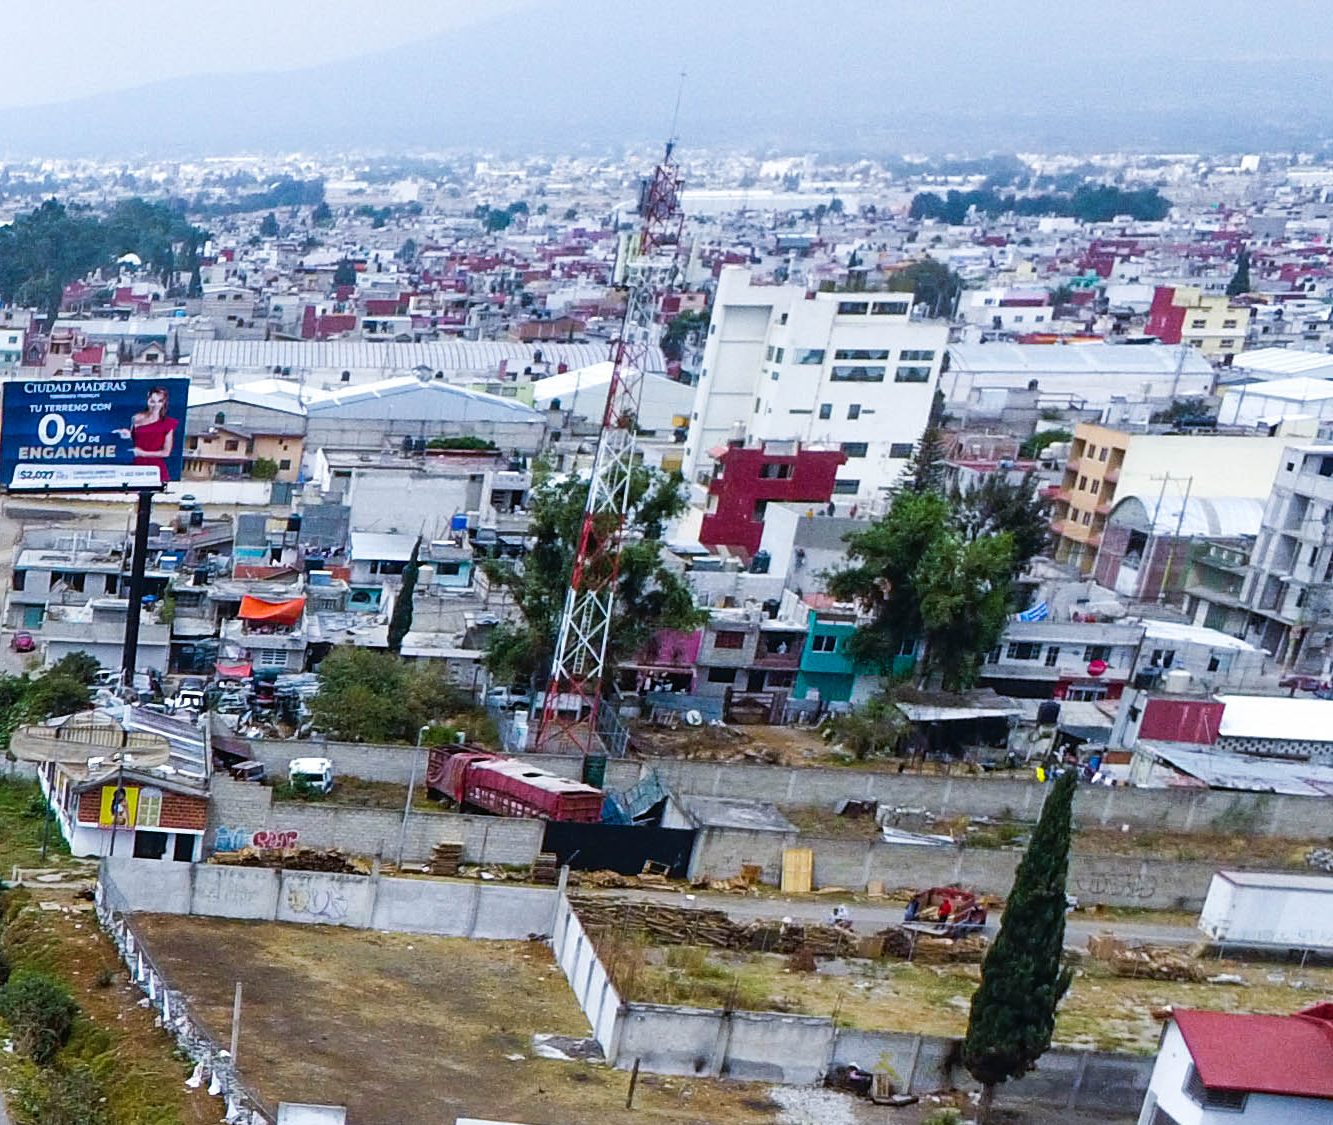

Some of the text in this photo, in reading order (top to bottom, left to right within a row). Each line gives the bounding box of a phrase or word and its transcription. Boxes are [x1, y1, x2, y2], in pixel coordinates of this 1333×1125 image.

[24, 381, 127, 393] CIUDAD MADERAS
[29, 402, 112, 413] TU TERRENO CON
[18, 445, 116, 460] ENGANCHE
